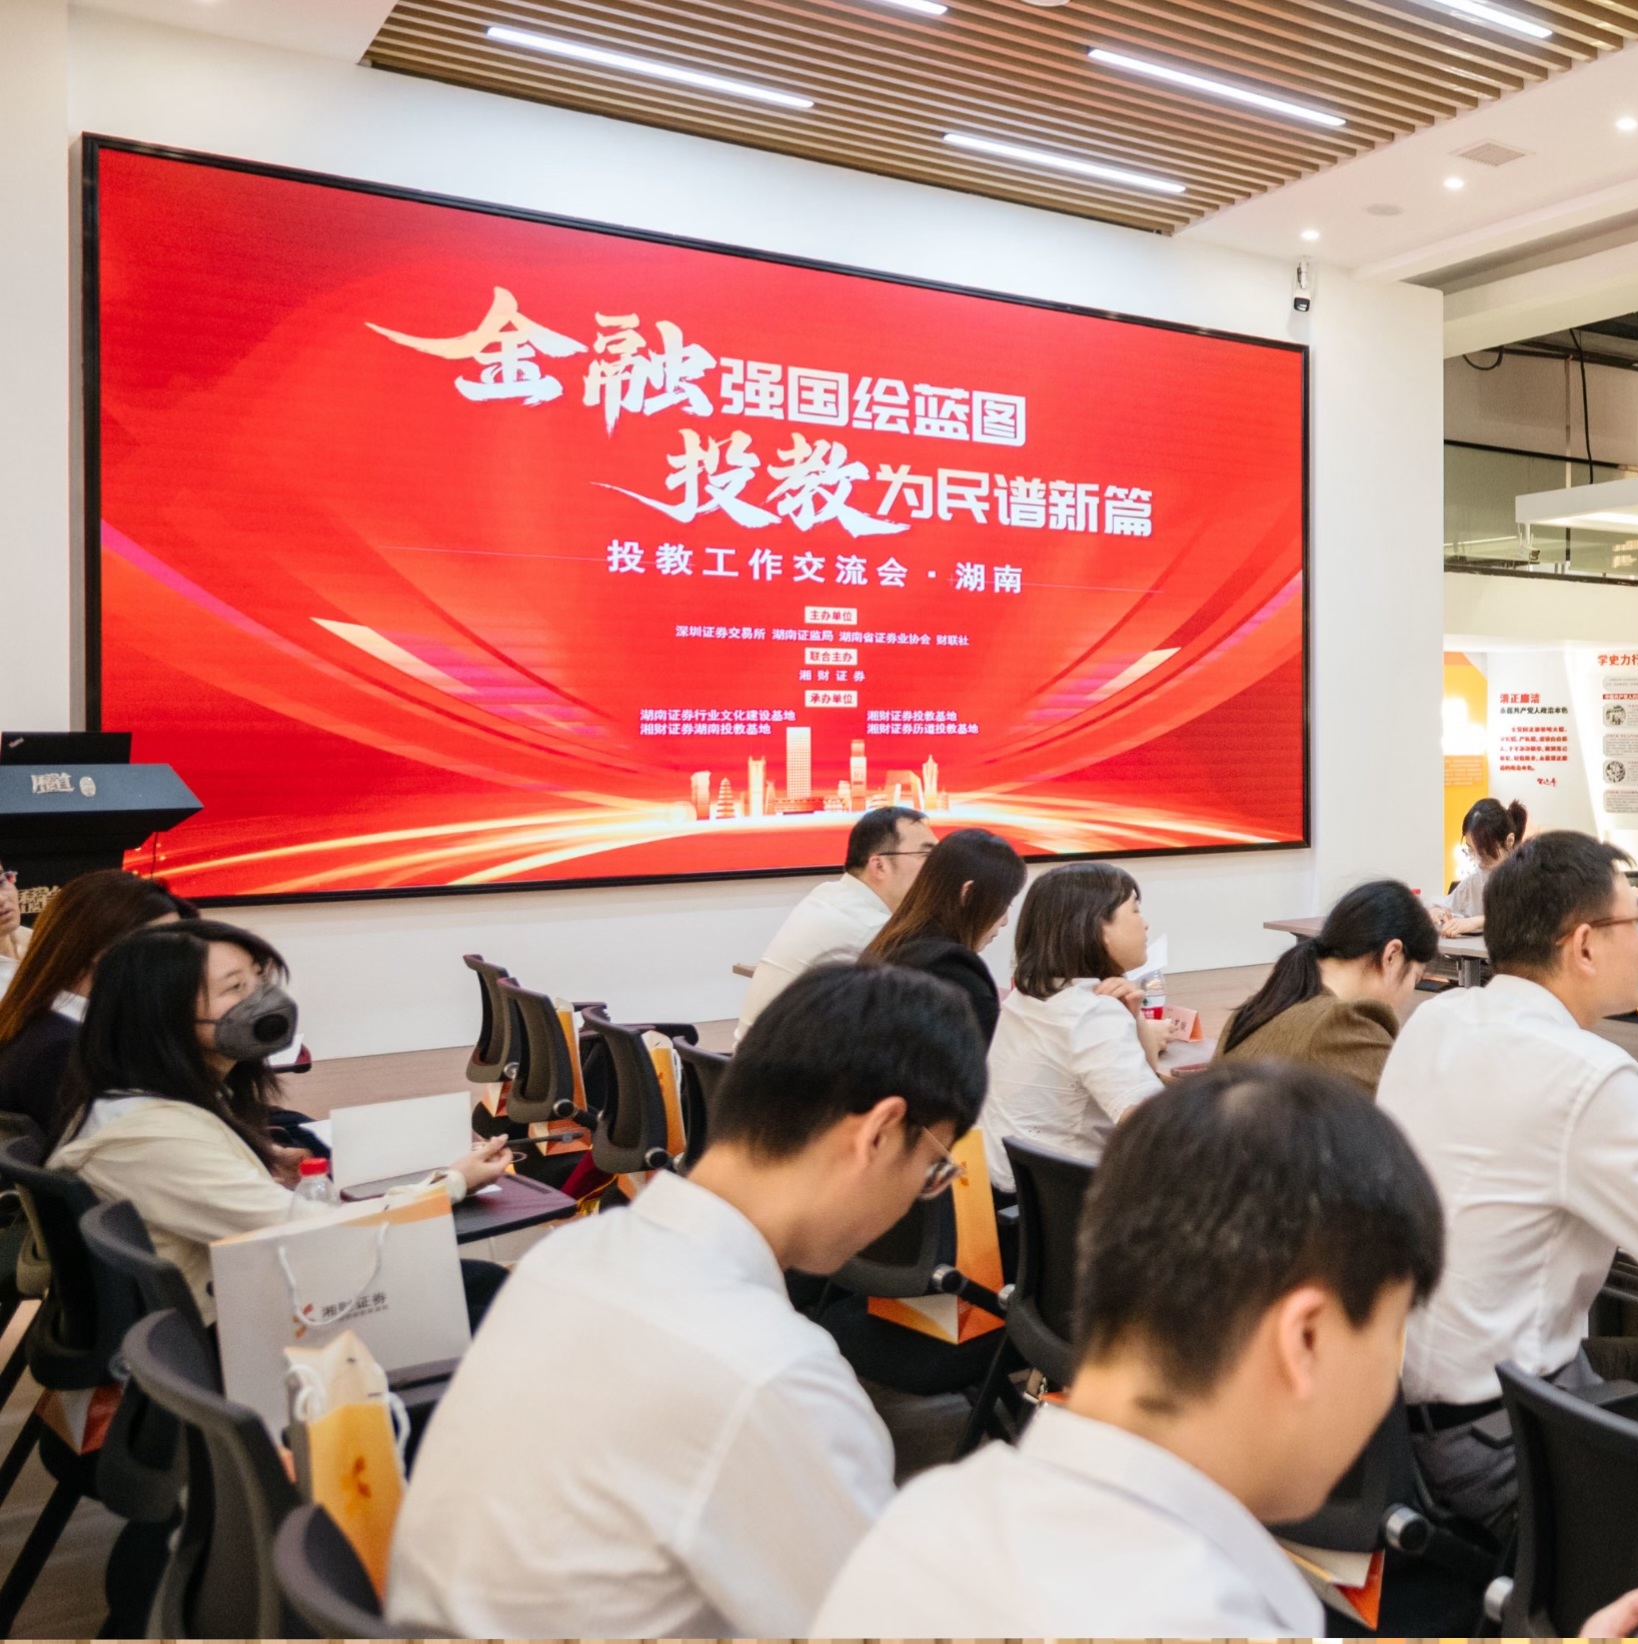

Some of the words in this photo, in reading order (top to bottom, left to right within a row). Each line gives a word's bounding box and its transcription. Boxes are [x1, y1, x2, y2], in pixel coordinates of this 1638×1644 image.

[364, 286, 1026, 447] 金融强国绘蓝图
[591, 428, 1154, 538] 投教为民谱新篇
[809, 609, 854, 622] 主办单位
[676, 626, 766, 640] 深圳证券交易所
[772, 629, 834, 643] 湖南证监局
[839, 631, 931, 645] 湖南省证券业协会
[936, 635, 970, 647] 财联社
[809, 651, 854, 663] 联合主办
[799, 670, 866, 682] 湘财证券
[809, 693, 854, 705] 承办单位
[640, 709, 796, 722] 湖南证券行业文化建设基地
[867, 710, 958, 722] 湘财证券投教基地
[640, 723, 772, 735] 湘财证券湖南投教基地
[867, 723, 979, 735] 湘财证券历道投教基地
